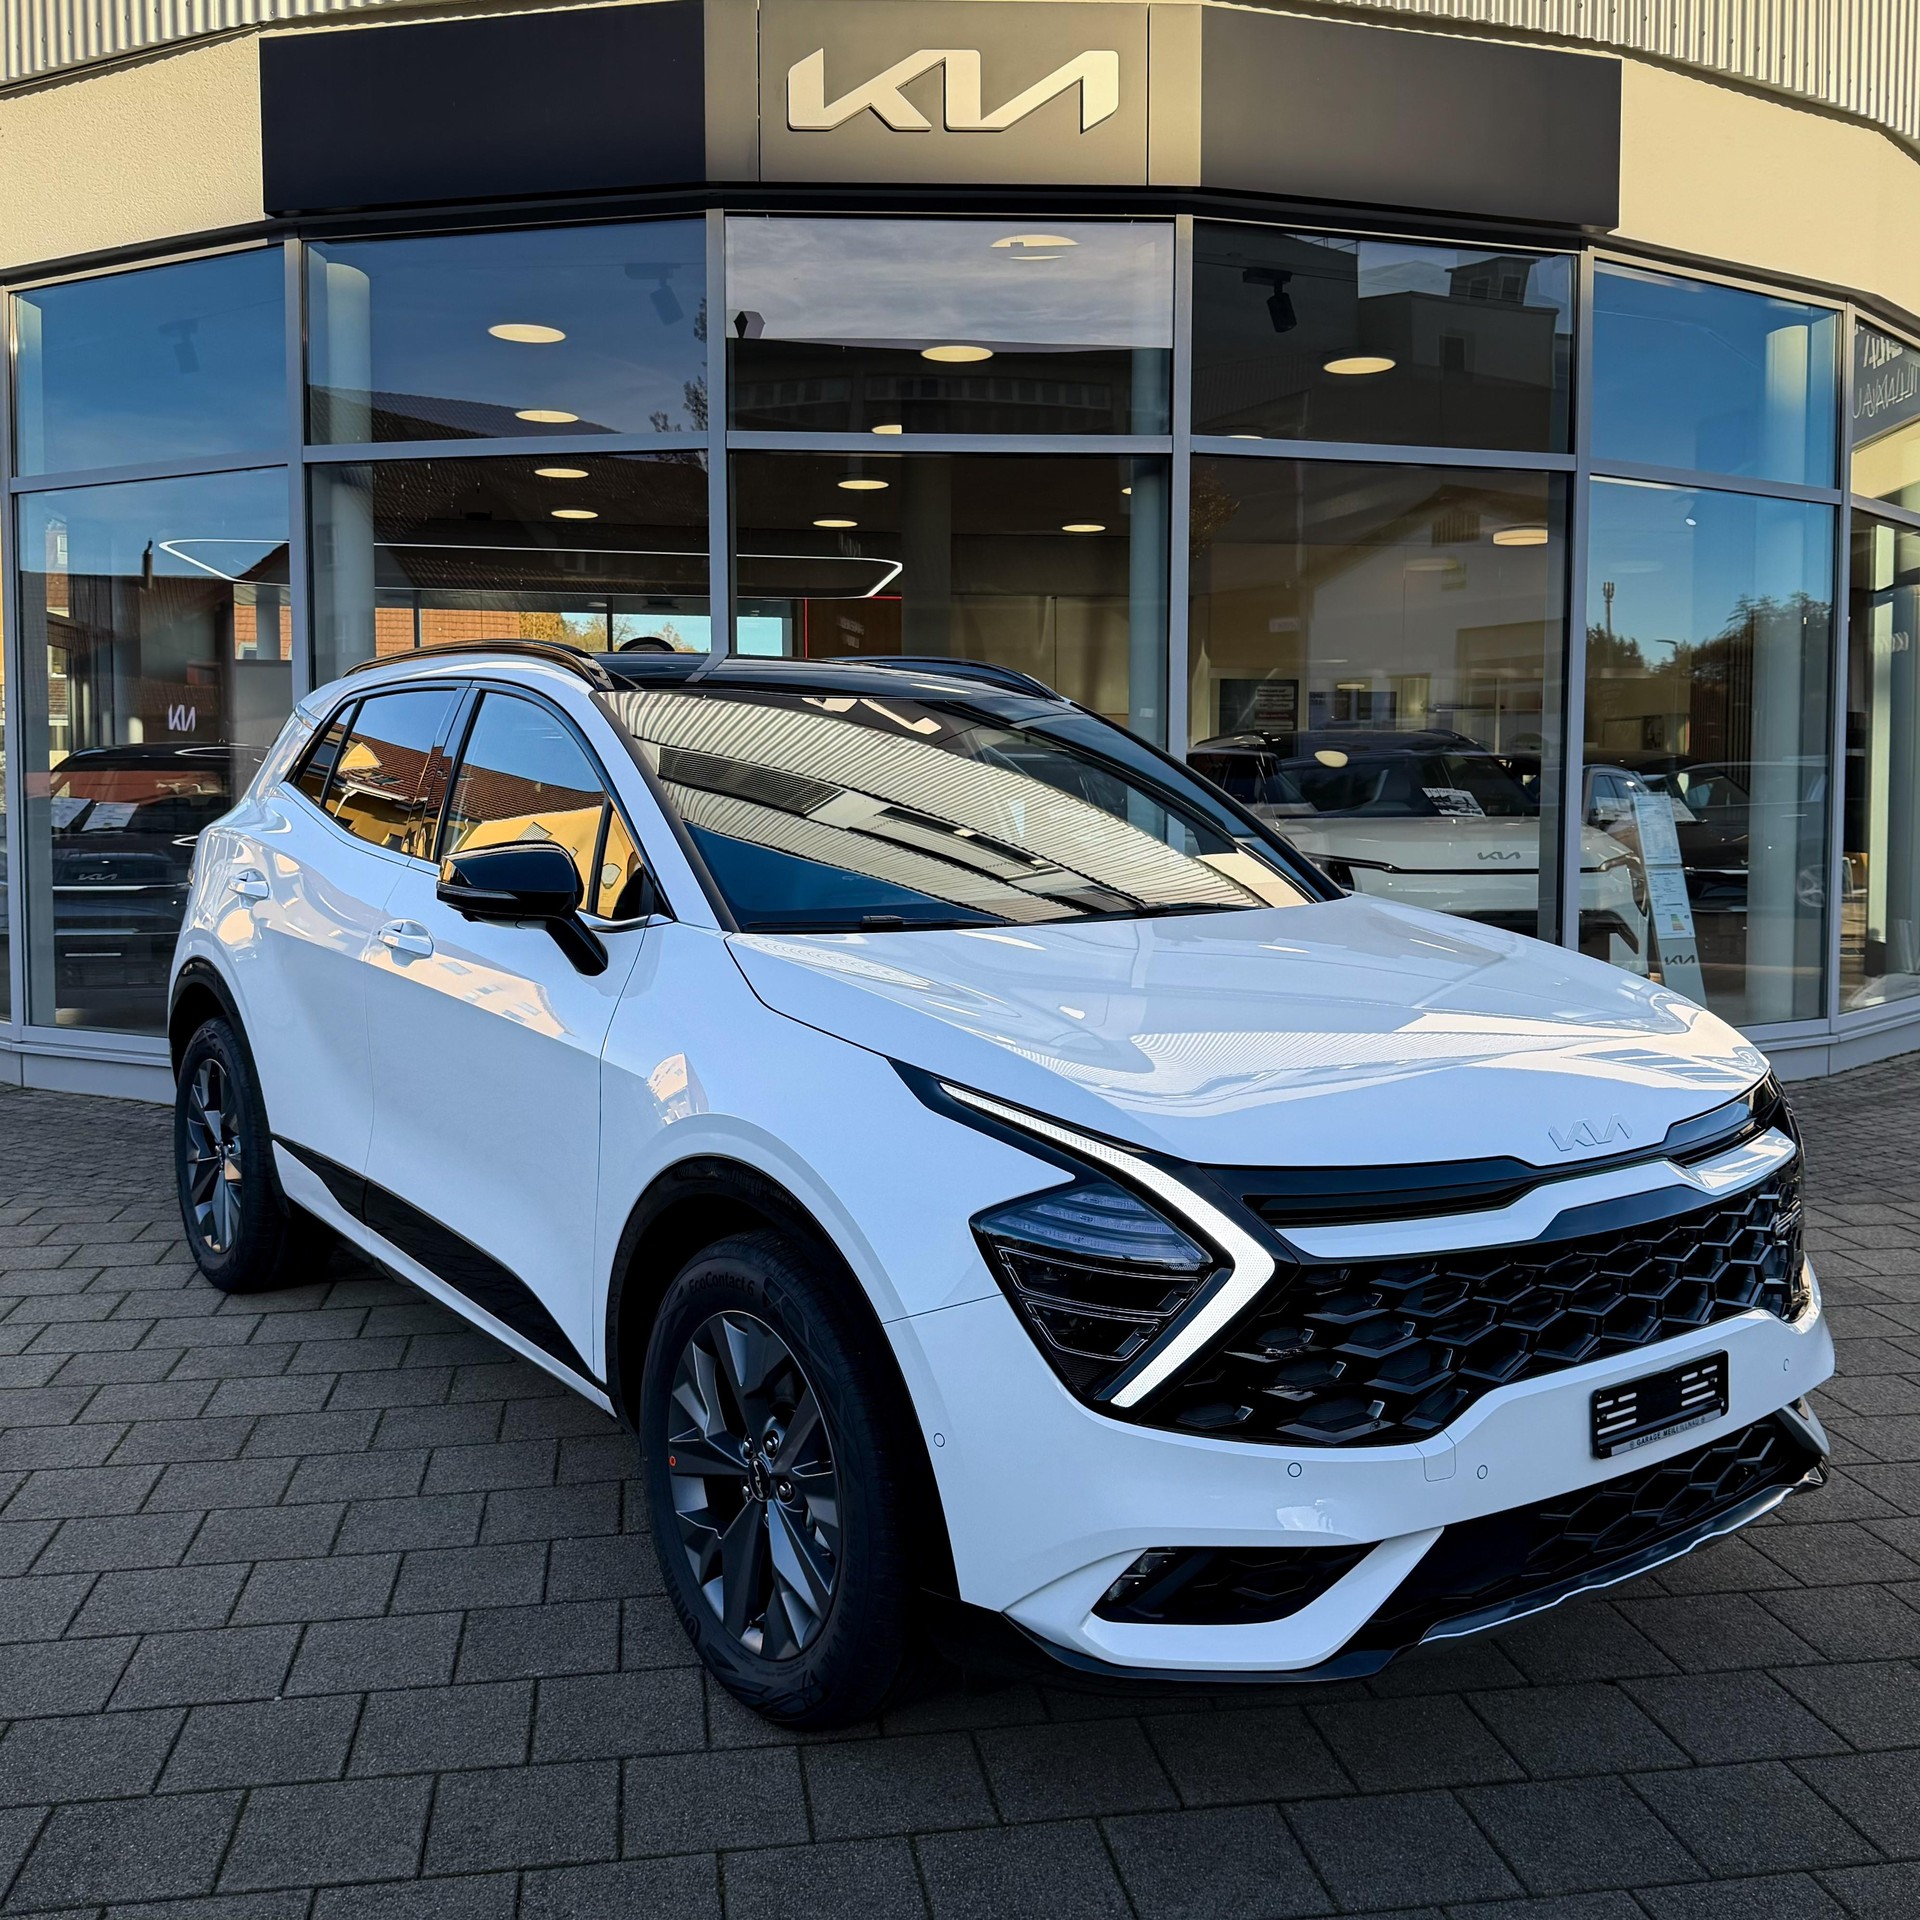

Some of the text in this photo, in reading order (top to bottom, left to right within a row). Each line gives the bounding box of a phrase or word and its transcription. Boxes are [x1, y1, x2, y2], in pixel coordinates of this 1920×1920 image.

[787, 47, 1120, 134] KIA
[168, 704, 196, 732] KIA
[1477, 851, 1521, 861] KIA
[1664, 954, 1696, 966] KIA
[1547, 1112, 1632, 1152] KIA
[1636, 1431, 1661, 1447] GARAGE
